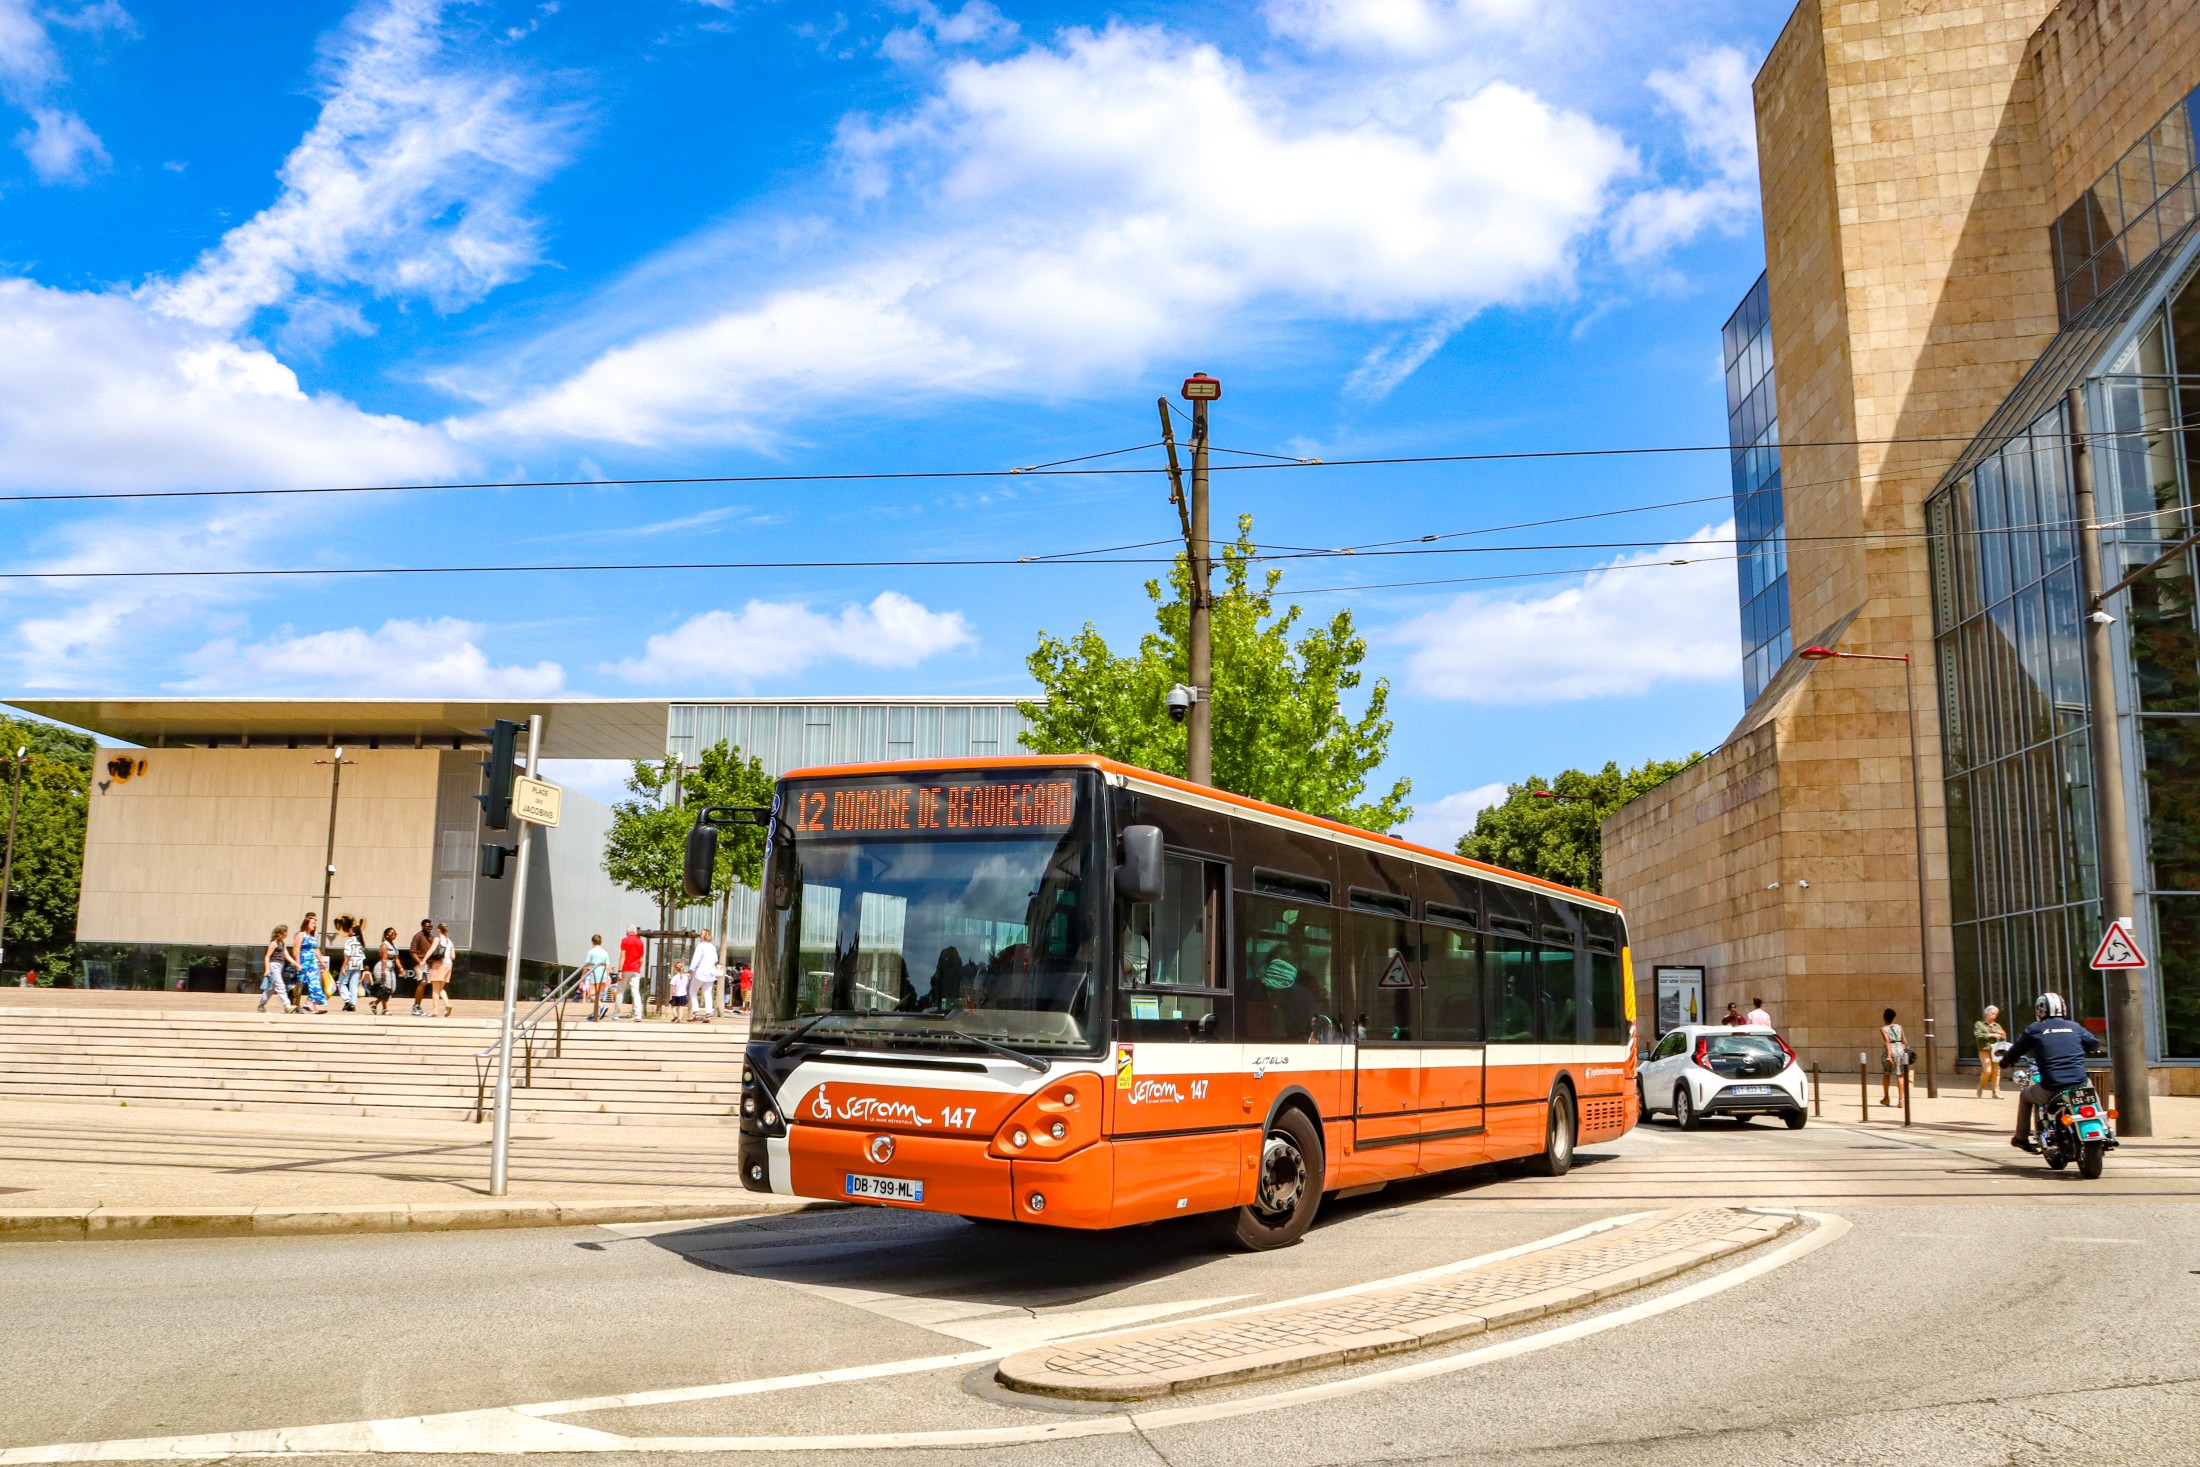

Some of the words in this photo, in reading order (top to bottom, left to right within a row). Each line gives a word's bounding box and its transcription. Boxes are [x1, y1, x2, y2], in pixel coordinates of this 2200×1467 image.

[532, 786, 548, 796] PLACE
[523, 805, 553, 819] JACOBINS
[796, 792, 827, 831] 12
[832, 788, 912, 831] DOMAINE
[918, 787, 942, 828] DE
[947, 782, 1072, 828] BEAUREGARD
[1190, 1079, 1209, 1100] 147
[941, 1106, 977, 1129] 147
